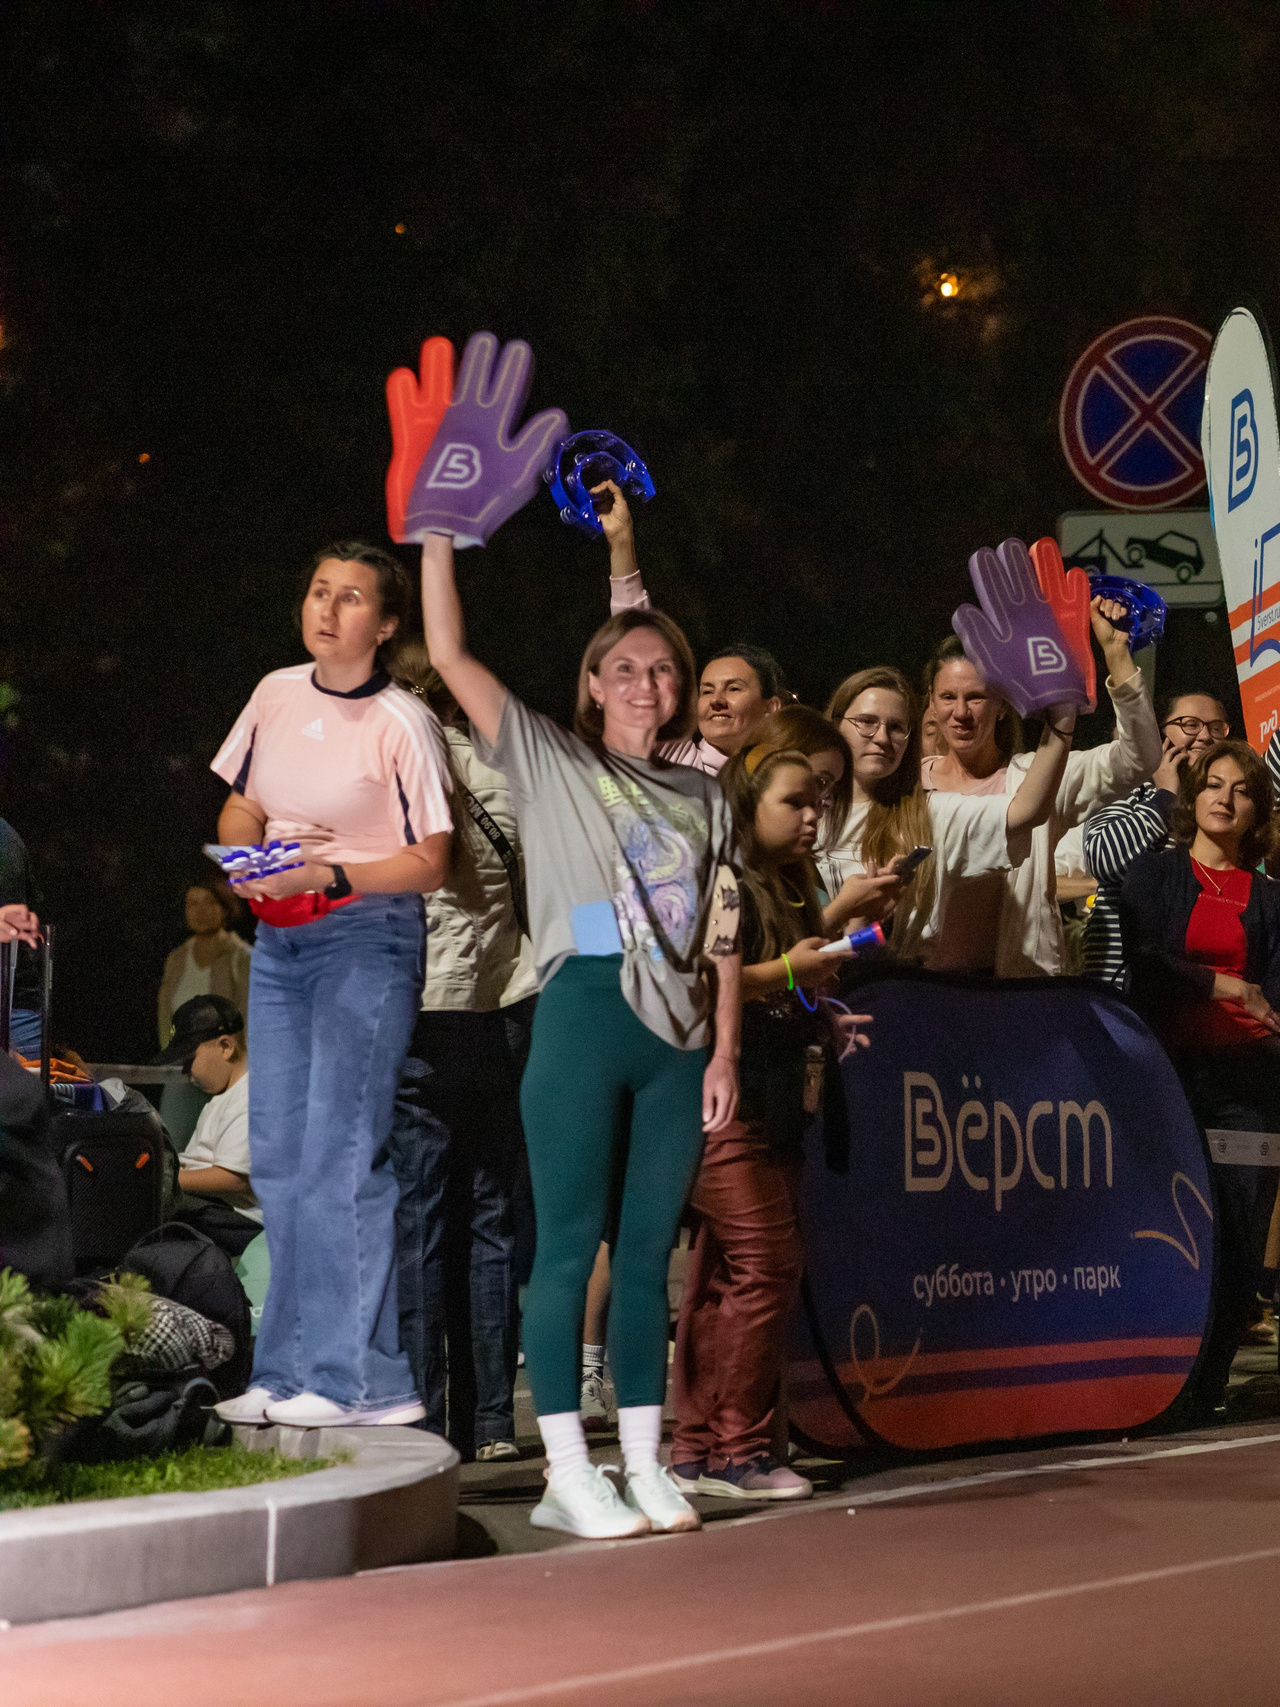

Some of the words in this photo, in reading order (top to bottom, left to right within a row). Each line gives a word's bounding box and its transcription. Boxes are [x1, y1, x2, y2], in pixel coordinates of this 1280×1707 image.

[1257, 606, 1280, 631] 5verst.ru
[913, 1263, 995, 1307] суббота
[1010, 1270, 1057, 1302] утро
[1073, 1264, 1122, 1299] парк
